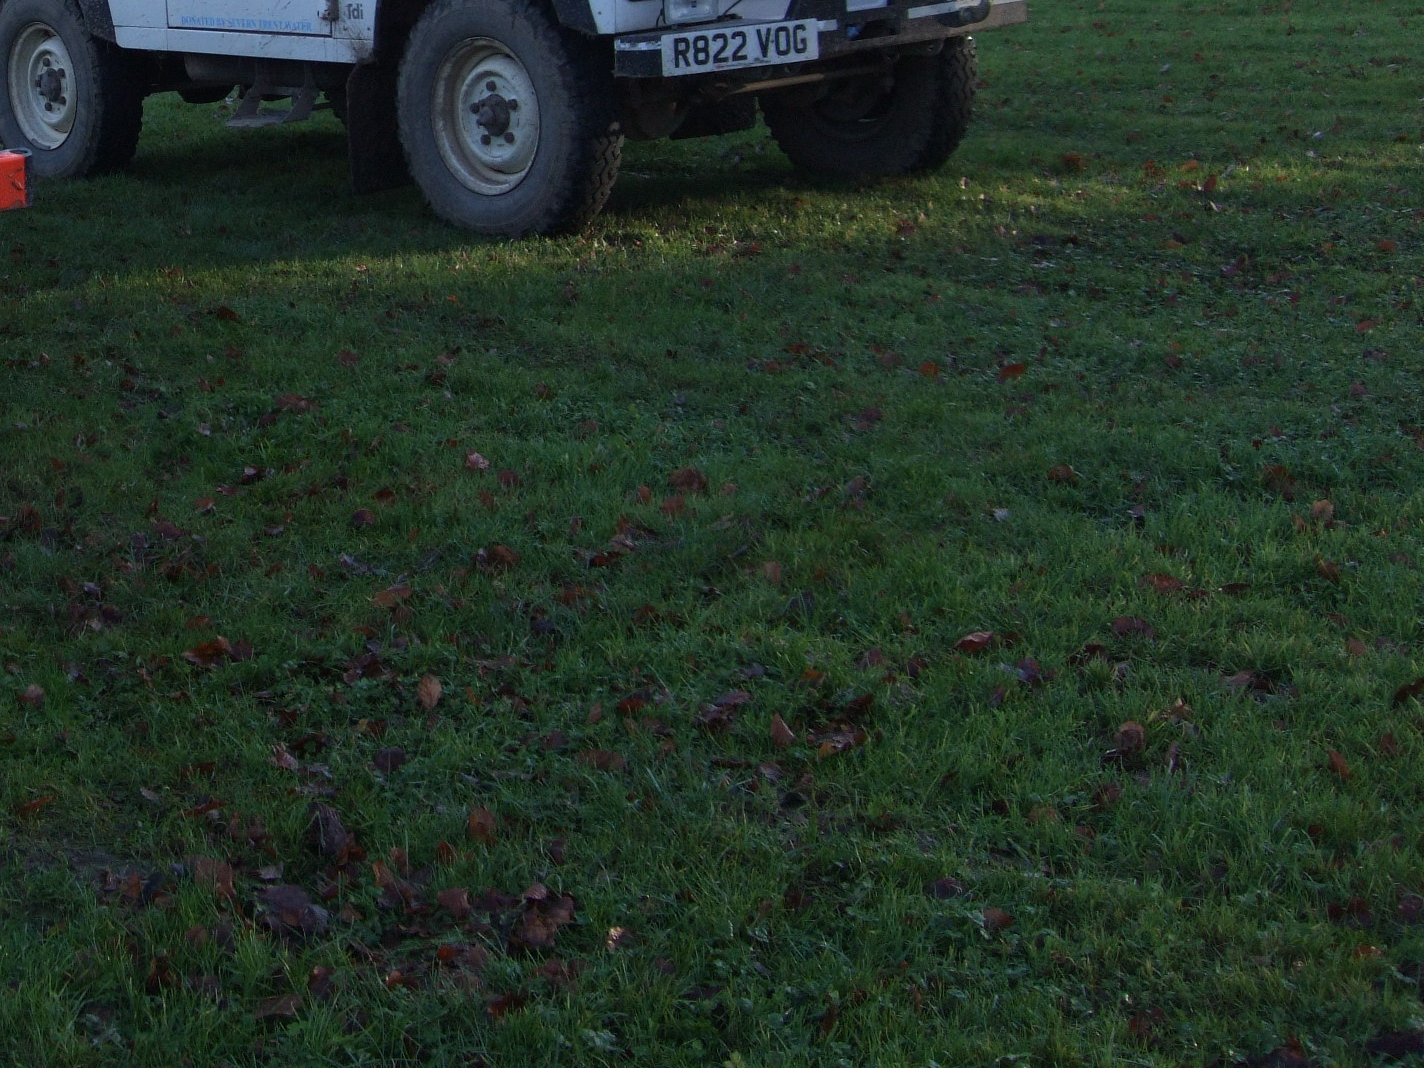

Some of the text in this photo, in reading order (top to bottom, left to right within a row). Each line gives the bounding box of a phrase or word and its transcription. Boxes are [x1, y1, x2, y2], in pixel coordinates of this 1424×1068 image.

[345, 3, 364, 20] Tdi
[181, 15, 215, 27] DONATED
[227, 18, 257, 29] SEVERN
[674, 24, 808, 68] R822 VOG
